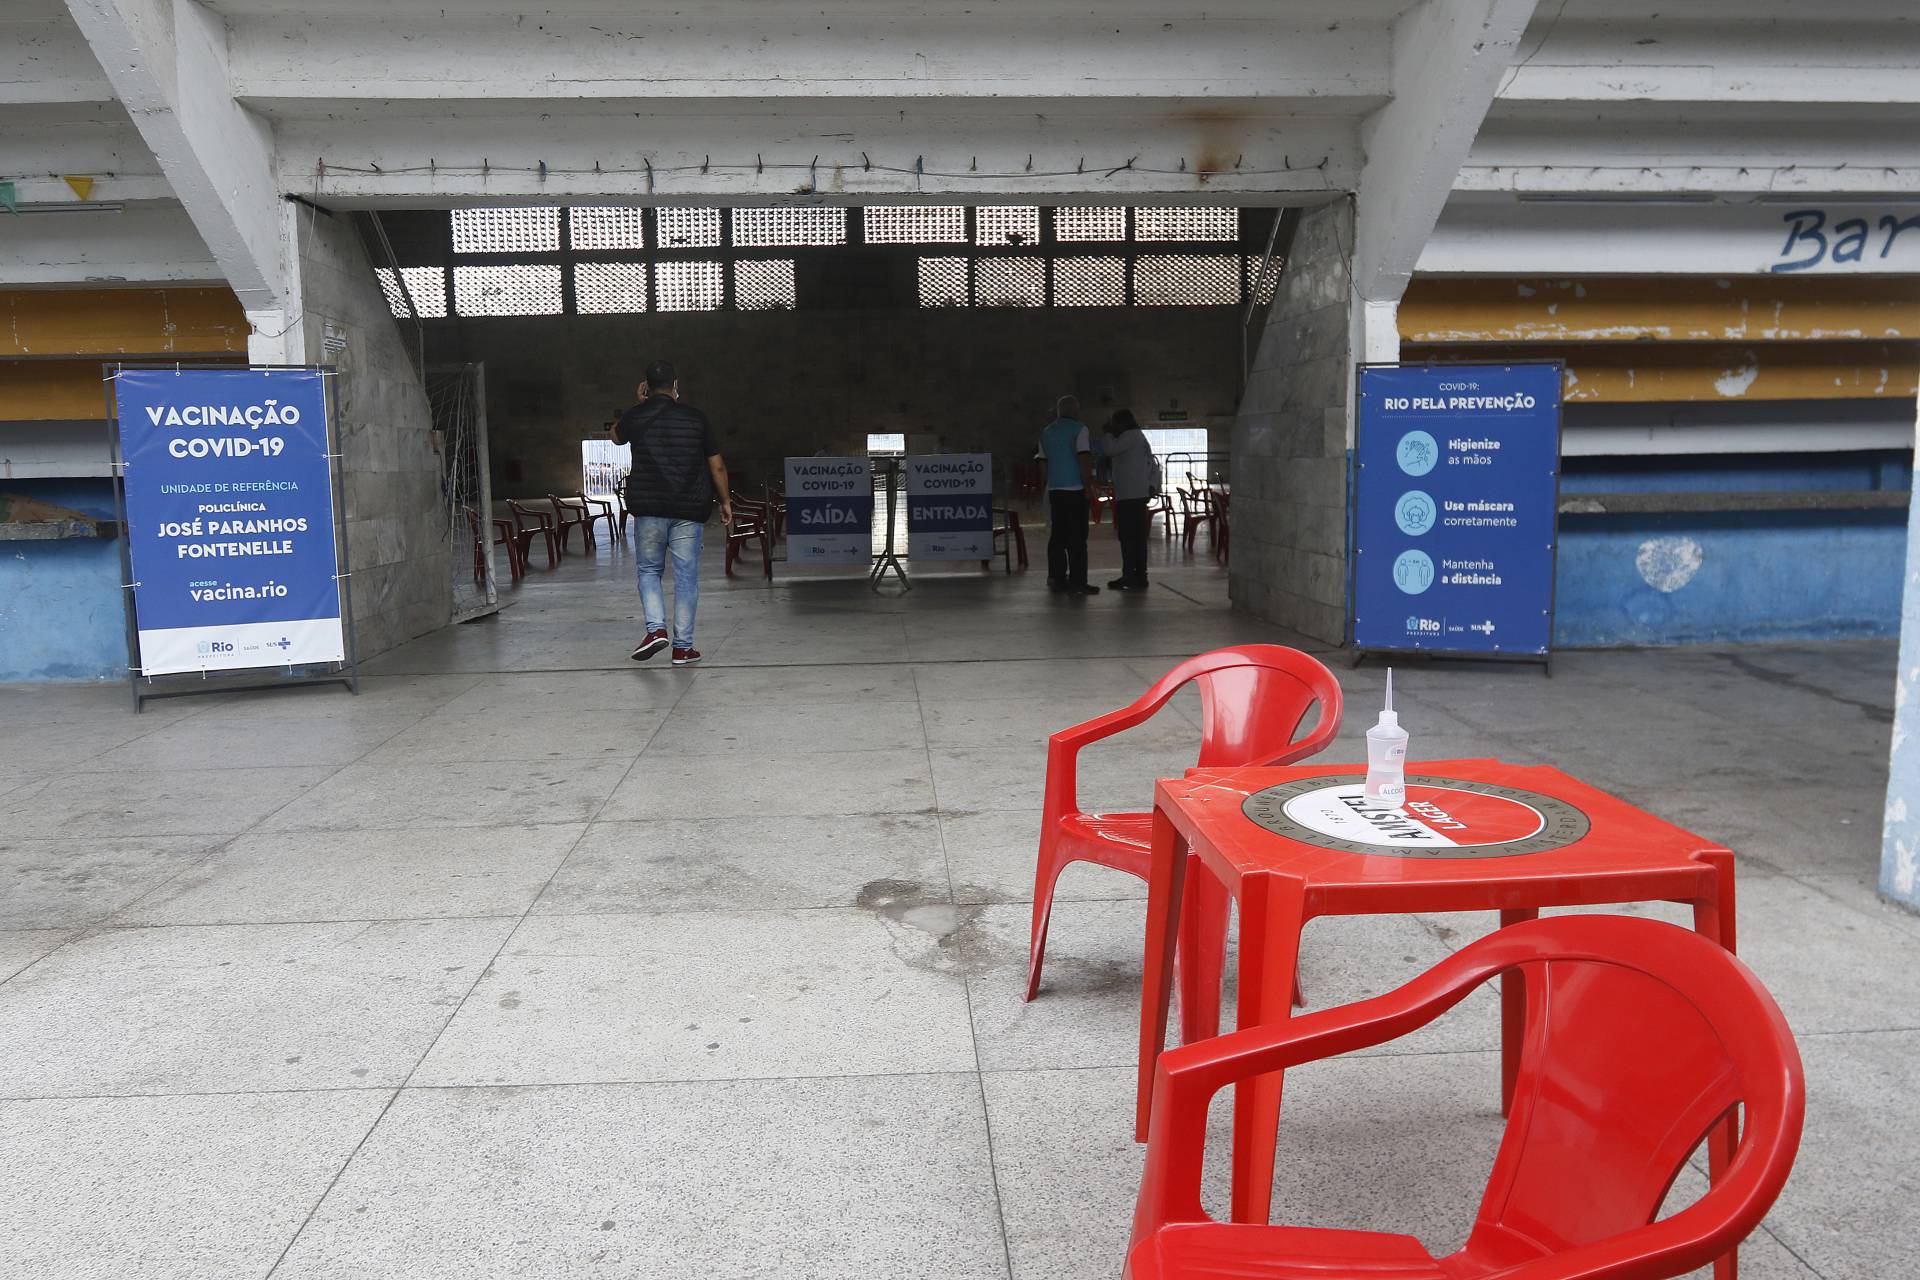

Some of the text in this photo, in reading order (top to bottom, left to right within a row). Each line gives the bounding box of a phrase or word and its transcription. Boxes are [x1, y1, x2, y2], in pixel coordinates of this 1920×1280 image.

[1439, 382, 1480, 392] COVID-19:
[1385, 393, 1536, 412] RIO PELA PREVENÇÃO
[146, 400, 300, 430] VACINAÇÃO
[168, 437, 285, 459] COVID-19
[1449, 438, 1501, 453] Higienize
[1448, 452, 1492, 465] as mãos
[793, 463, 863, 477] VACINAÇÃO
[915, 460, 984, 475] VACINAÇÃO
[160, 481, 299, 494] UNIDADE DE REFERÊNCIA
[802, 480, 855, 490] COVID-19
[924, 478, 976, 489] COVID-19
[198, 501, 266, 513] POLICLÍNICA
[1444, 500, 1514, 512] Use máscara
[801, 504, 858, 524] SAÍDA
[912, 506, 988, 521] ENTRADA
[158, 517, 308, 538] JOSÉ PARANHOS
[1444, 516, 1517, 528] corretamente
[177, 540, 293, 559] FONTENELLE
[1442, 559, 1494, 570] Mantenha
[1442, 573, 1502, 585] a distância
[190, 581, 288, 602] vacina.rio
[1419, 619, 1440, 631] Rio
[211, 642, 234, 653] Rio
[1408, 801, 1468, 830] LAGER
